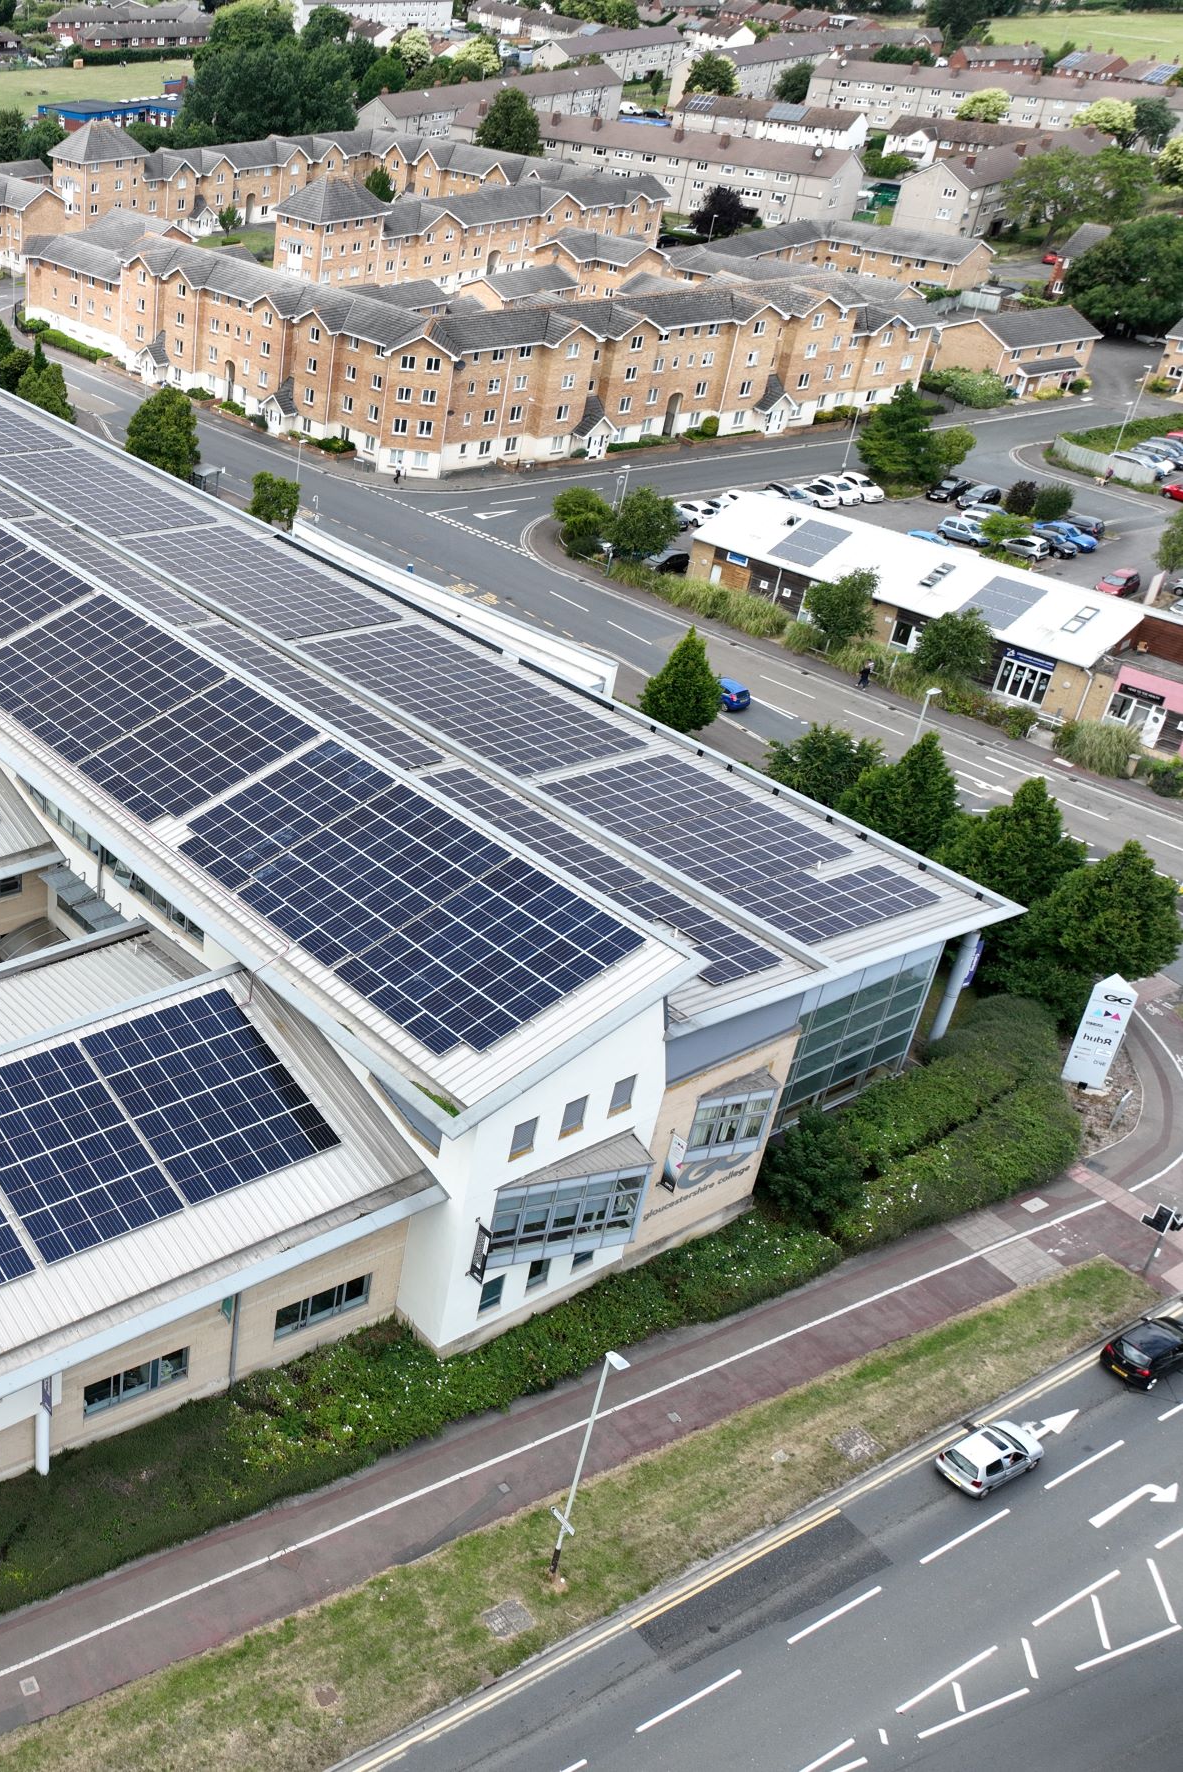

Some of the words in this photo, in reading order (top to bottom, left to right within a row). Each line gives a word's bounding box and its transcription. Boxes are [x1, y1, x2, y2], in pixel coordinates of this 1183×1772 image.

[1104, 994, 1132, 1005] GC
[643, 1182, 714, 1222] gloucestershire
[717, 1165, 751, 1184] college
